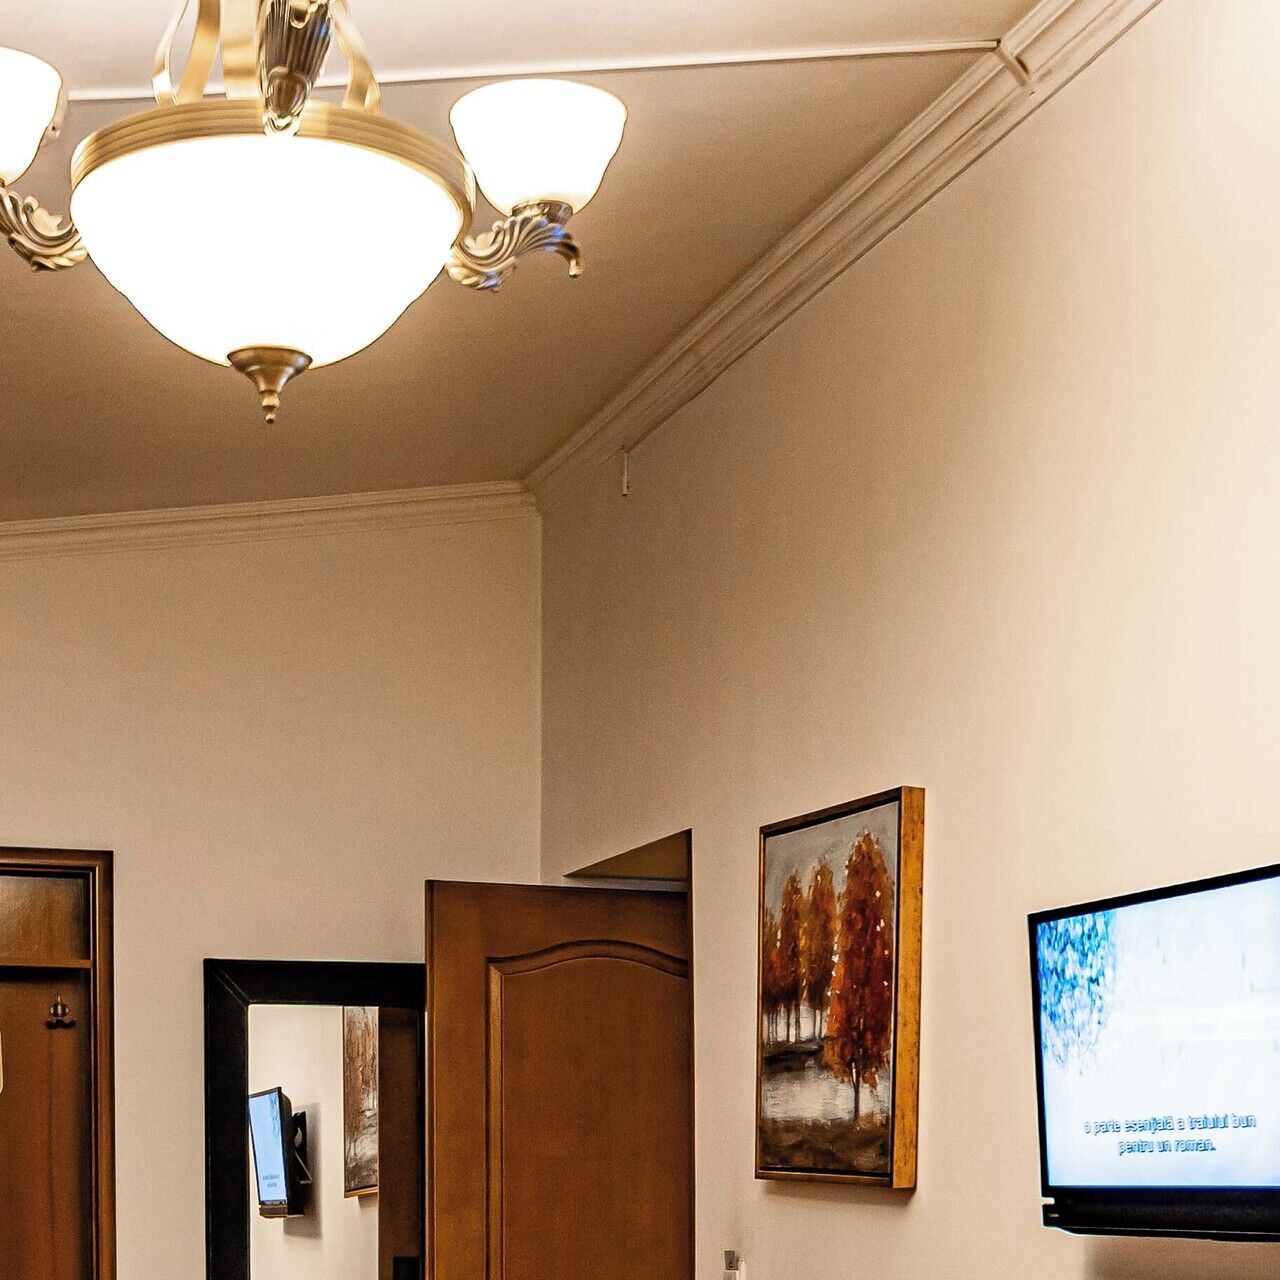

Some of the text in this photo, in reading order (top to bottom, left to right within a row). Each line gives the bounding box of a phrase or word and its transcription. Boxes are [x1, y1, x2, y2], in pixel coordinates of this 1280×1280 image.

[1084, 1120, 1091, 1134] o
[1094, 1119, 1121, 1136] parte
[1178, 1117, 1185, 1131] a
[1188, 1112, 1229, 1130] traiului
[1231, 1112, 1257, 1129] bun
[1118, 1139, 1154, 1156] pentru
[1157, 1140, 1172, 1153] un
